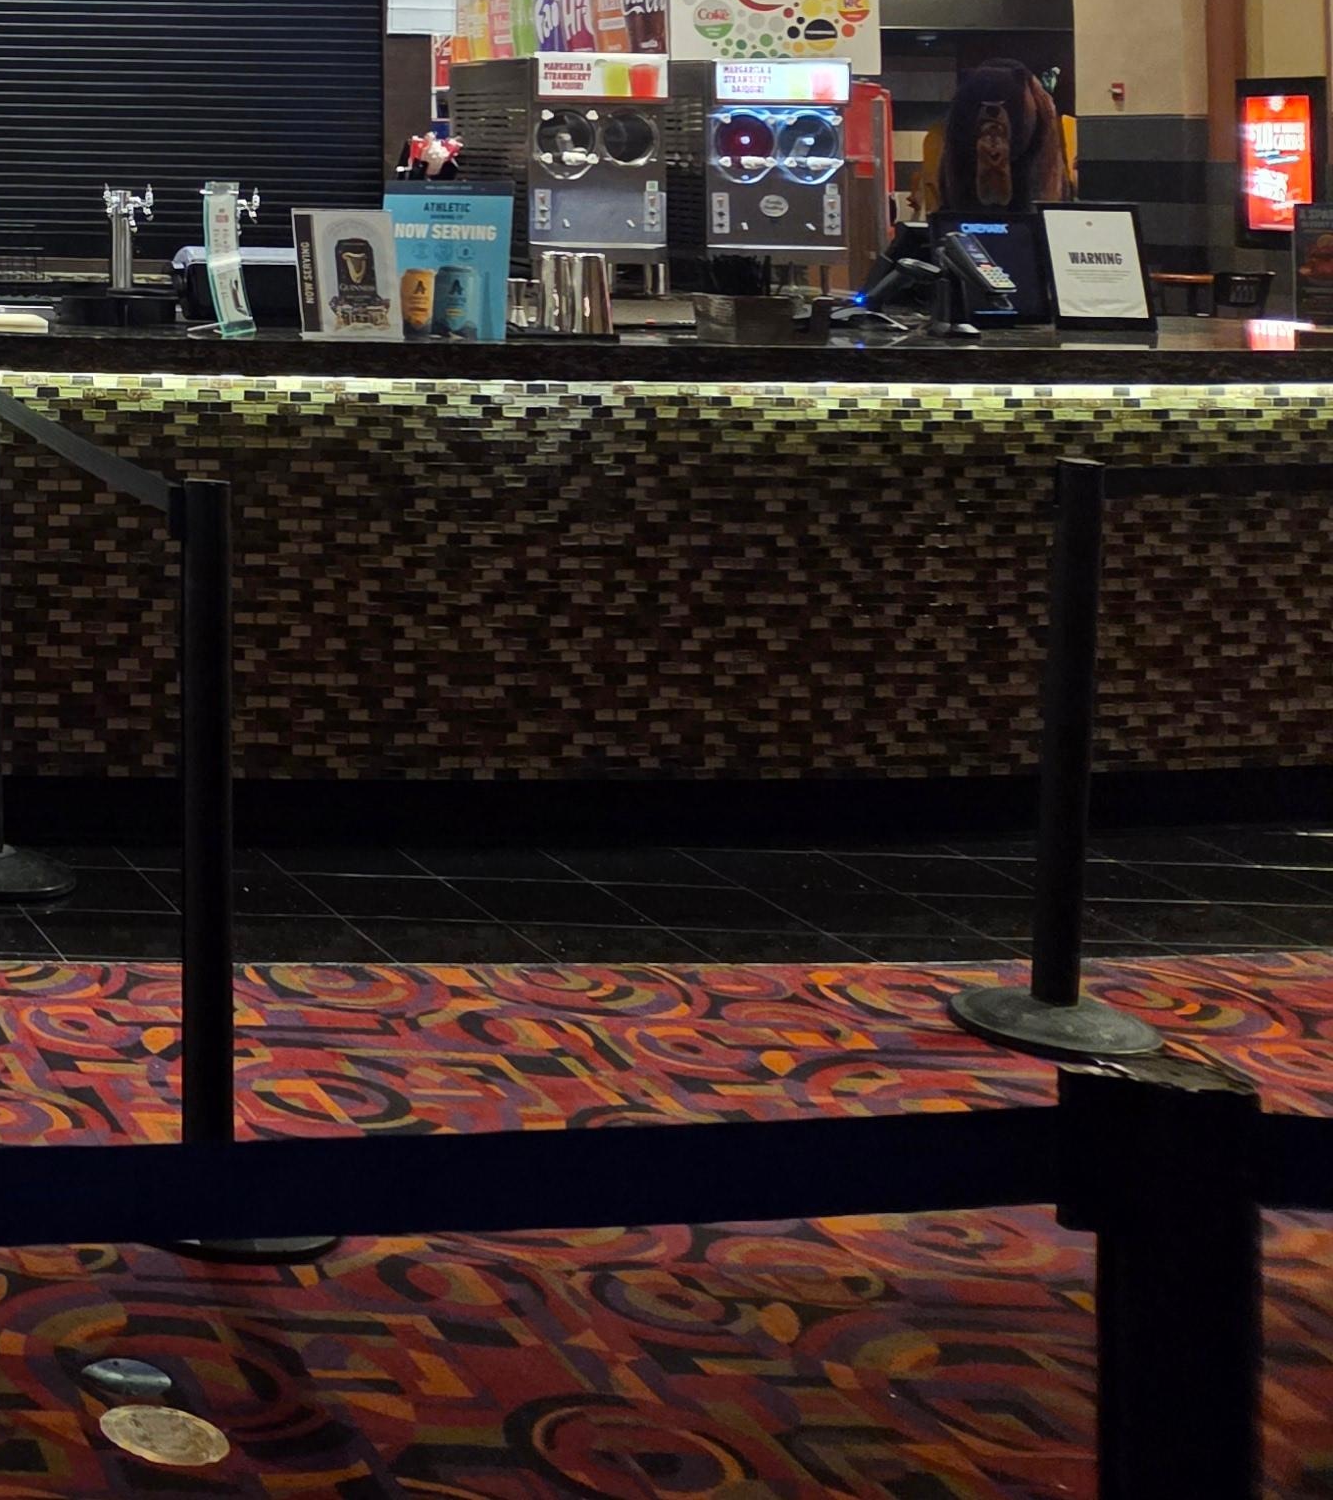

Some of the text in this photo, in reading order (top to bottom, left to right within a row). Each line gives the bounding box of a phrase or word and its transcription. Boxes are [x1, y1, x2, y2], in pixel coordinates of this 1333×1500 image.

[697, 8, 730, 21] Coke
[544, 62, 584, 72] MARGARITA
[543, 72, 591, 81] STRAWBERRY
[424, 202, 471, 213] ATHLETIC
[394, 223, 498, 241] NOW SERVING
[960, 223, 1009, 234] CINEMARK
[1068, 252, 1123, 265] WARNING
[300, 241, 315, 305] NOW SERVING
[339, 283, 375, 291] GUINNESS
